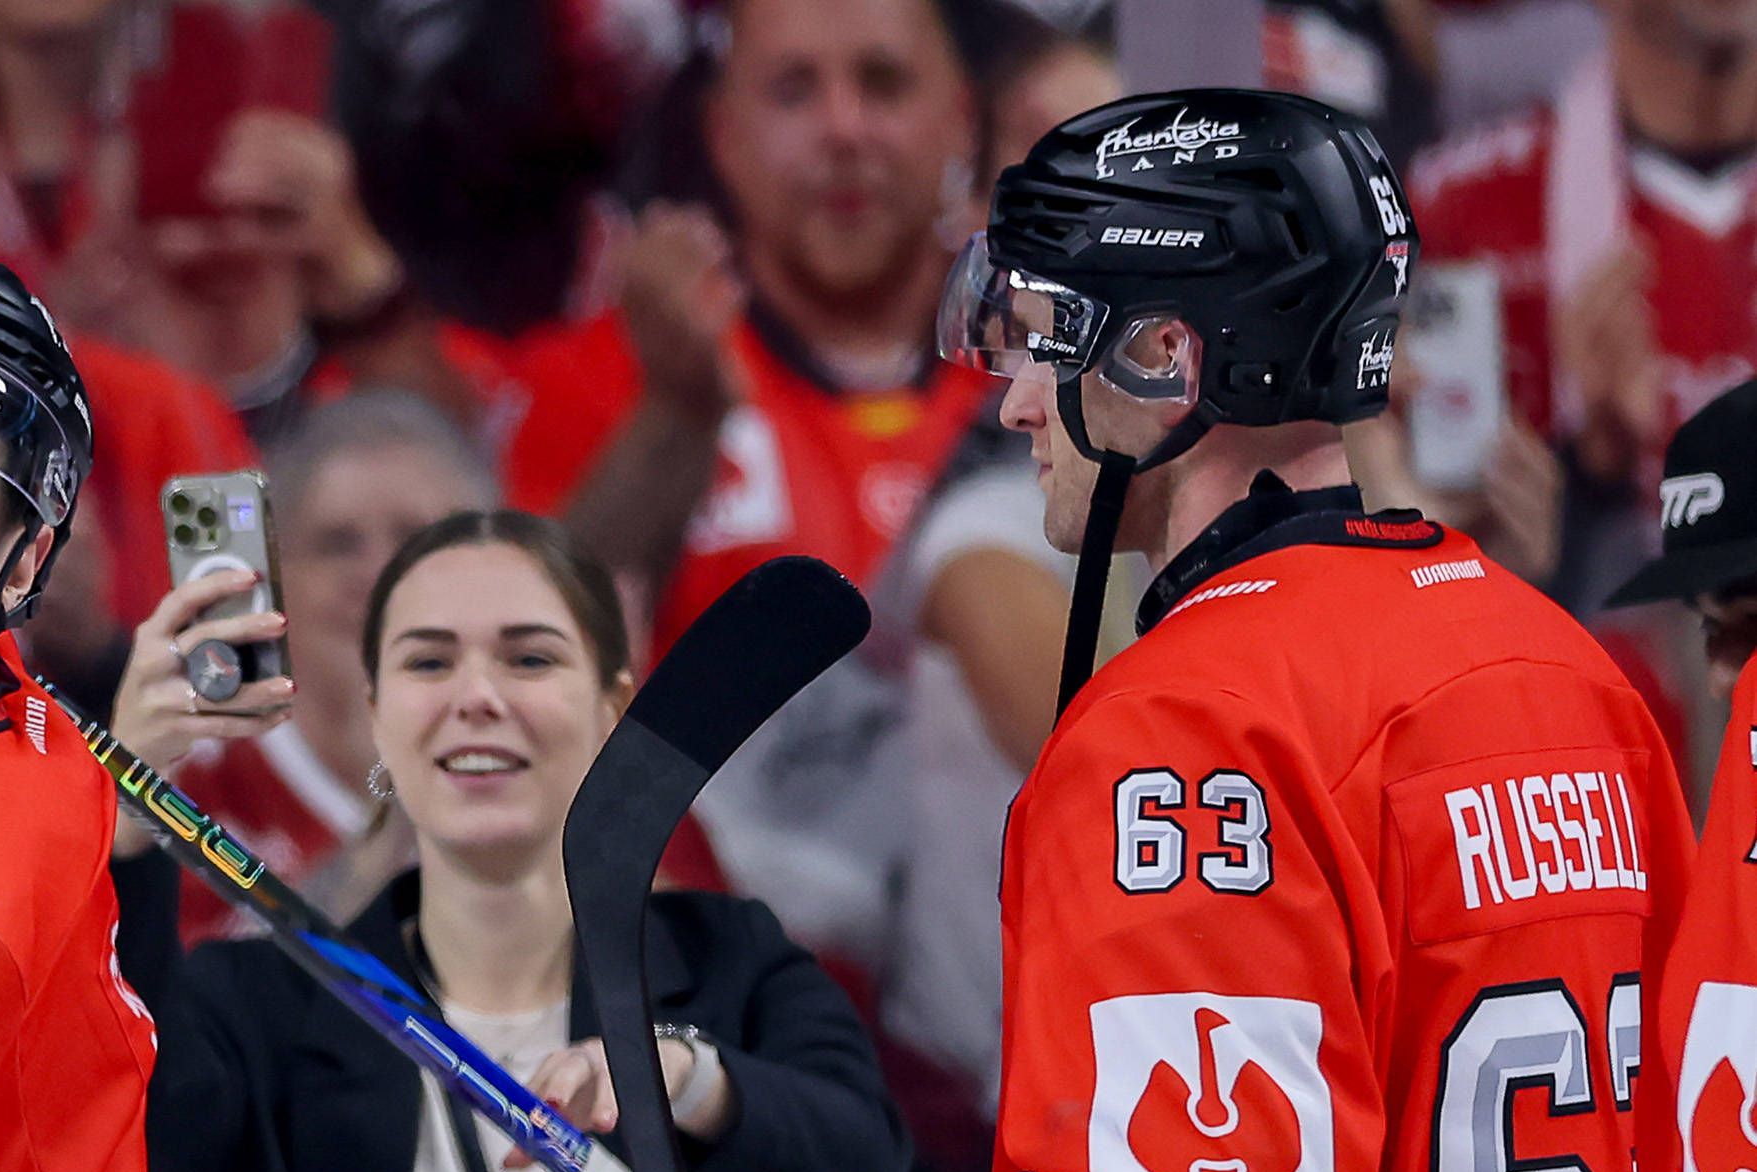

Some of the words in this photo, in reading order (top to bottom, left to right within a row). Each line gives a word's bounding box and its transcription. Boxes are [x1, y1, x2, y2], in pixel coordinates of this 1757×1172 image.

[1096, 106, 1246, 167] Phantasia
[1096, 145, 1239, 180] LAND
[1100, 226, 1204, 248] BAUER
[1031, 334, 1077, 355] AUER
[1356, 371, 1389, 390] LAN
[1411, 559, 1486, 588] WARRIOR
[1113, 767, 1274, 896] 63
[1445, 772, 1647, 908] RUSSELL
